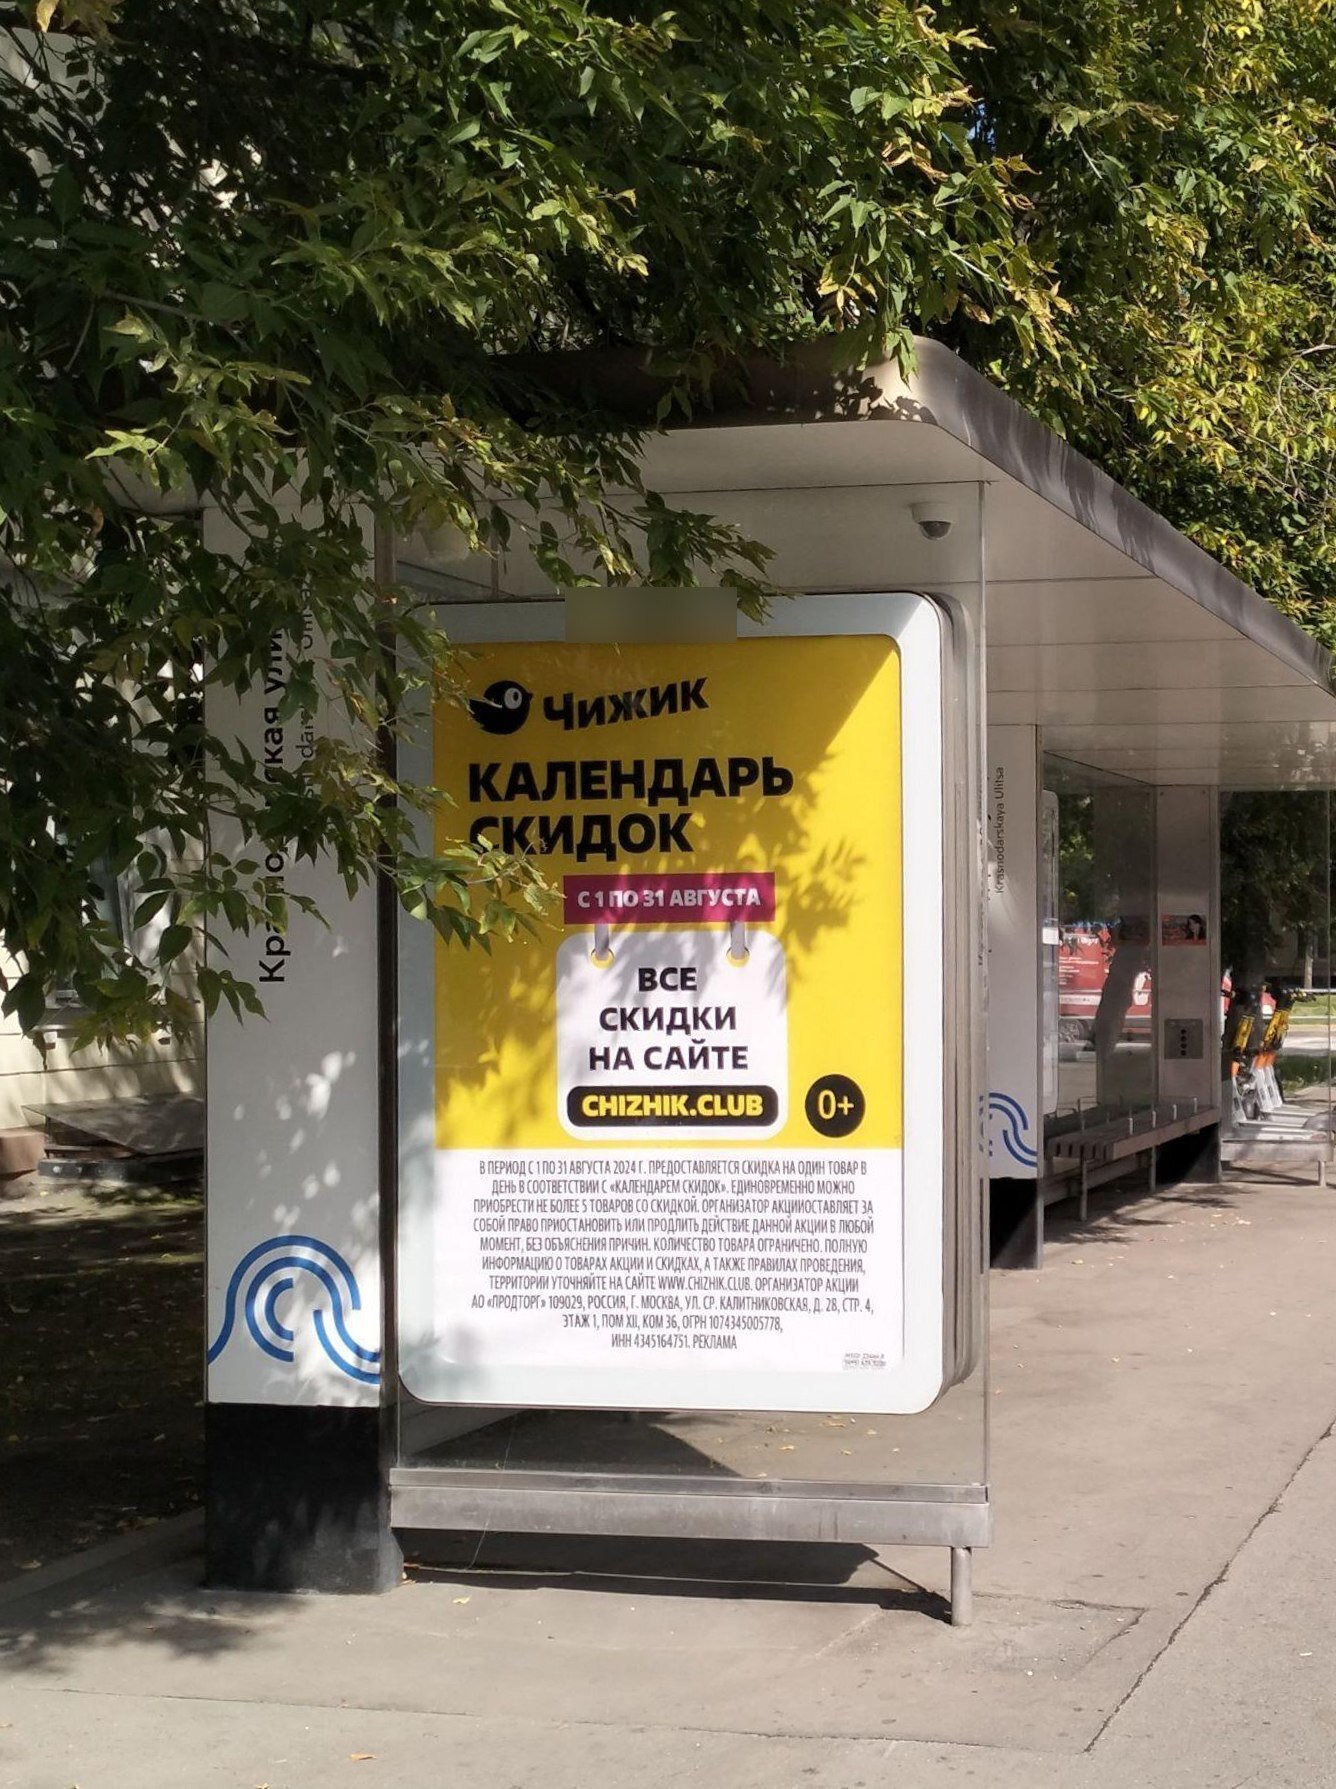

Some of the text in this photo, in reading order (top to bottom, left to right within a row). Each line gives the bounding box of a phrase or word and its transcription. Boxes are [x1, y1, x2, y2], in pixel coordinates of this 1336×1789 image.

[469, 757, 794, 807] КАЛЕНДАРЬ
[470, 813, 694, 862] СКИДОК
[577, 886, 761, 908] С 1 ПО 31 АВГУСТА
[638, 967, 697, 992] ВСЕ
[599, 1006, 737, 1036] СКИДКИ
[588, 1039, 748, 1071] НА САЙТЕ
[582, 1094, 764, 1117] CHIZHIK.CLUB
[817, 1089, 855, 1119] 0+
[479, 1160, 486, 1174] В
[488, 1160, 526, 1176] ПЕРИОД
[528, 1160, 534, 1174] С
[536, 1160, 540, 1174] 1
[542, 1160, 556, 1174] ПО
[558, 1160, 568, 1174] 31
[569, 1160, 611, 1174] АВГУСТА
[613, 1160, 636, 1174] 2024
[649, 1160, 740, 1176] ПРЕДОСТАВЛЯЕТСЯ
[741, 1160, 781, 1176] СКИДКА
[782, 1160, 796, 1174] НА
[797, 1160, 826, 1176] ОДИН
[828, 1160, 859, 1174] ТОВАР
[861, 1160, 867, 1174] В
[491, 1180, 517, 1196] ДЕНЬ
[519, 1180, 525, 1193] В
[527, 1180, 600, 1193] СООТВЕТСТВИИ
[601, 1180, 607, 1193] С
[610, 1180, 681, 1196] «КАЛЕНДАРЕМ
[731, 1180, 815, 1196] ЕДИНОВРЕМЕННО
[817, 1180, 855, 1194] МОЖНО
[474, 1199, 535, 1213] ПРИОБРЕСТИ
[536, 1199, 549, 1213] НЕ
[550, 1199, 580, 1213] БОЛЕЕ
[582, 1199, 588, 1213] 5
[590, 1199, 634, 1213] ТОВАРОВ
[635, 1199, 649, 1213] СО
[702, 1200, 770, 1213] ОРГАНИЗАТОР
[861, 1200, 874, 1214] ЗА
[473, 1215, 874, 1235] СОБОЙ ПРАВО ПРИОСТАНОВИТЬ ИЛИ ПРОДЛИТЬ ДЕЙСТВИЕ ДАННОЙ АКЦИИ В ЛЮБОЙ
[526, 1238, 542, 1251] БЕЗ
[544, 1238, 607, 1251] ОБЪЯСНЕНИЯ
[654, 1238, 716, 1252] КОЛИЧЕСТВО
[718, 1239, 755, 1252] ТОВАРА
[825, 1239, 868, 1253] ПОЛНУЮ
[482, 1257, 554, 1273] ИНФОРМАЦИЮ
[556, 1257, 563, 1271] О
[565, 1257, 608, 1271] ТОВАРАХ
[610, 1257, 645, 1273] АКЦИИ
[646, 1257, 654, 1271] И
[704, 1258, 711, 1271] А
[714, 1258, 746, 1272] ТАКЖЕ
[748, 1258, 798, 1272] ПРАВИЛАХ
[489, 1276, 549, 1290] ТЕРРИТОРИИ
[551, 1273, 607, 1290] УТОЧНЯЙТЕ
[609, 1277, 623, 1290] НА
[625, 1274, 656, 1290] САЙТЕ
[755, 1278, 823, 1291] ОРГАНИЗАТОР
[825, 1278, 859, 1294] АКЦИИ
[471, 1295, 485, 1308] АО
[487, 1295, 546, 1311] «ПРОДТОРГ»
[563, 1315, 591, 1328] ЭТАЖ
[601, 1315, 624, 1329] ПОМ
[642, 1315, 664, 1329] КОМ
[682, 1316, 707, 1329] ОГРН
[611, 1334, 632, 1348] ИНН
[693, 1335, 738, 1349] РЕКЛАМА
